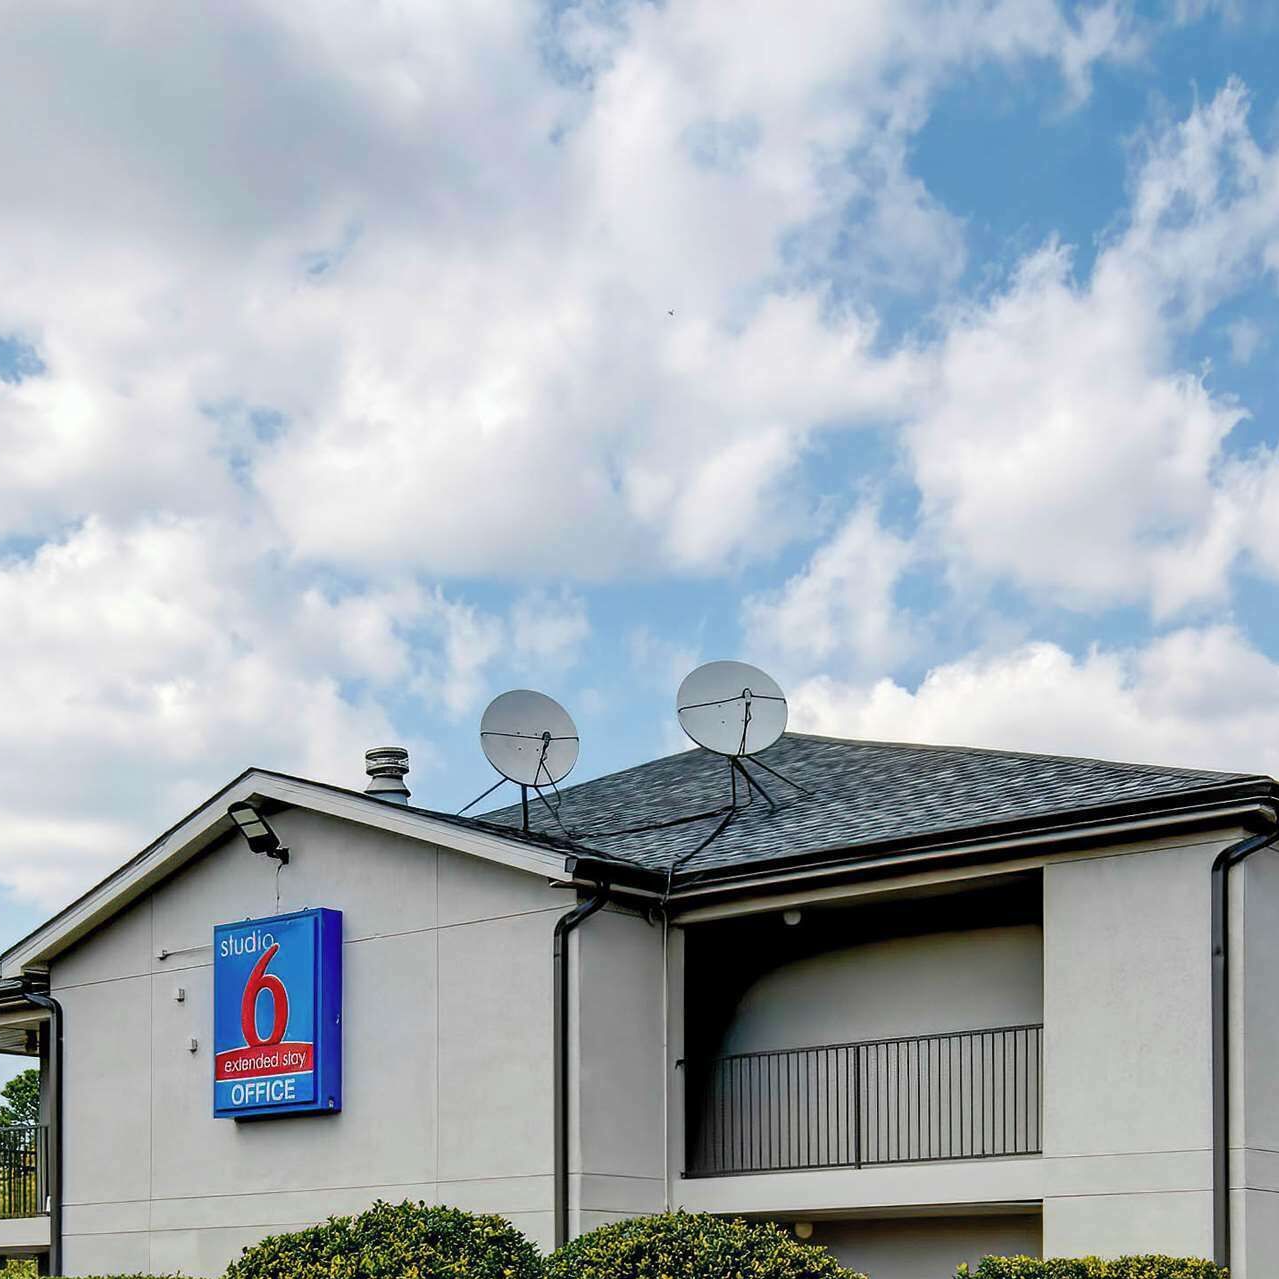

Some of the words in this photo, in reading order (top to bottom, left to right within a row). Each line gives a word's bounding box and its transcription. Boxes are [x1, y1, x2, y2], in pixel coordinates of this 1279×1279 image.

[220, 929, 274, 957] studio
[241, 942, 290, 1048] 6
[224, 1052, 279, 1073] extended
[282, 1050, 307, 1069] stay
[231, 1078, 296, 1105] OFFICE
